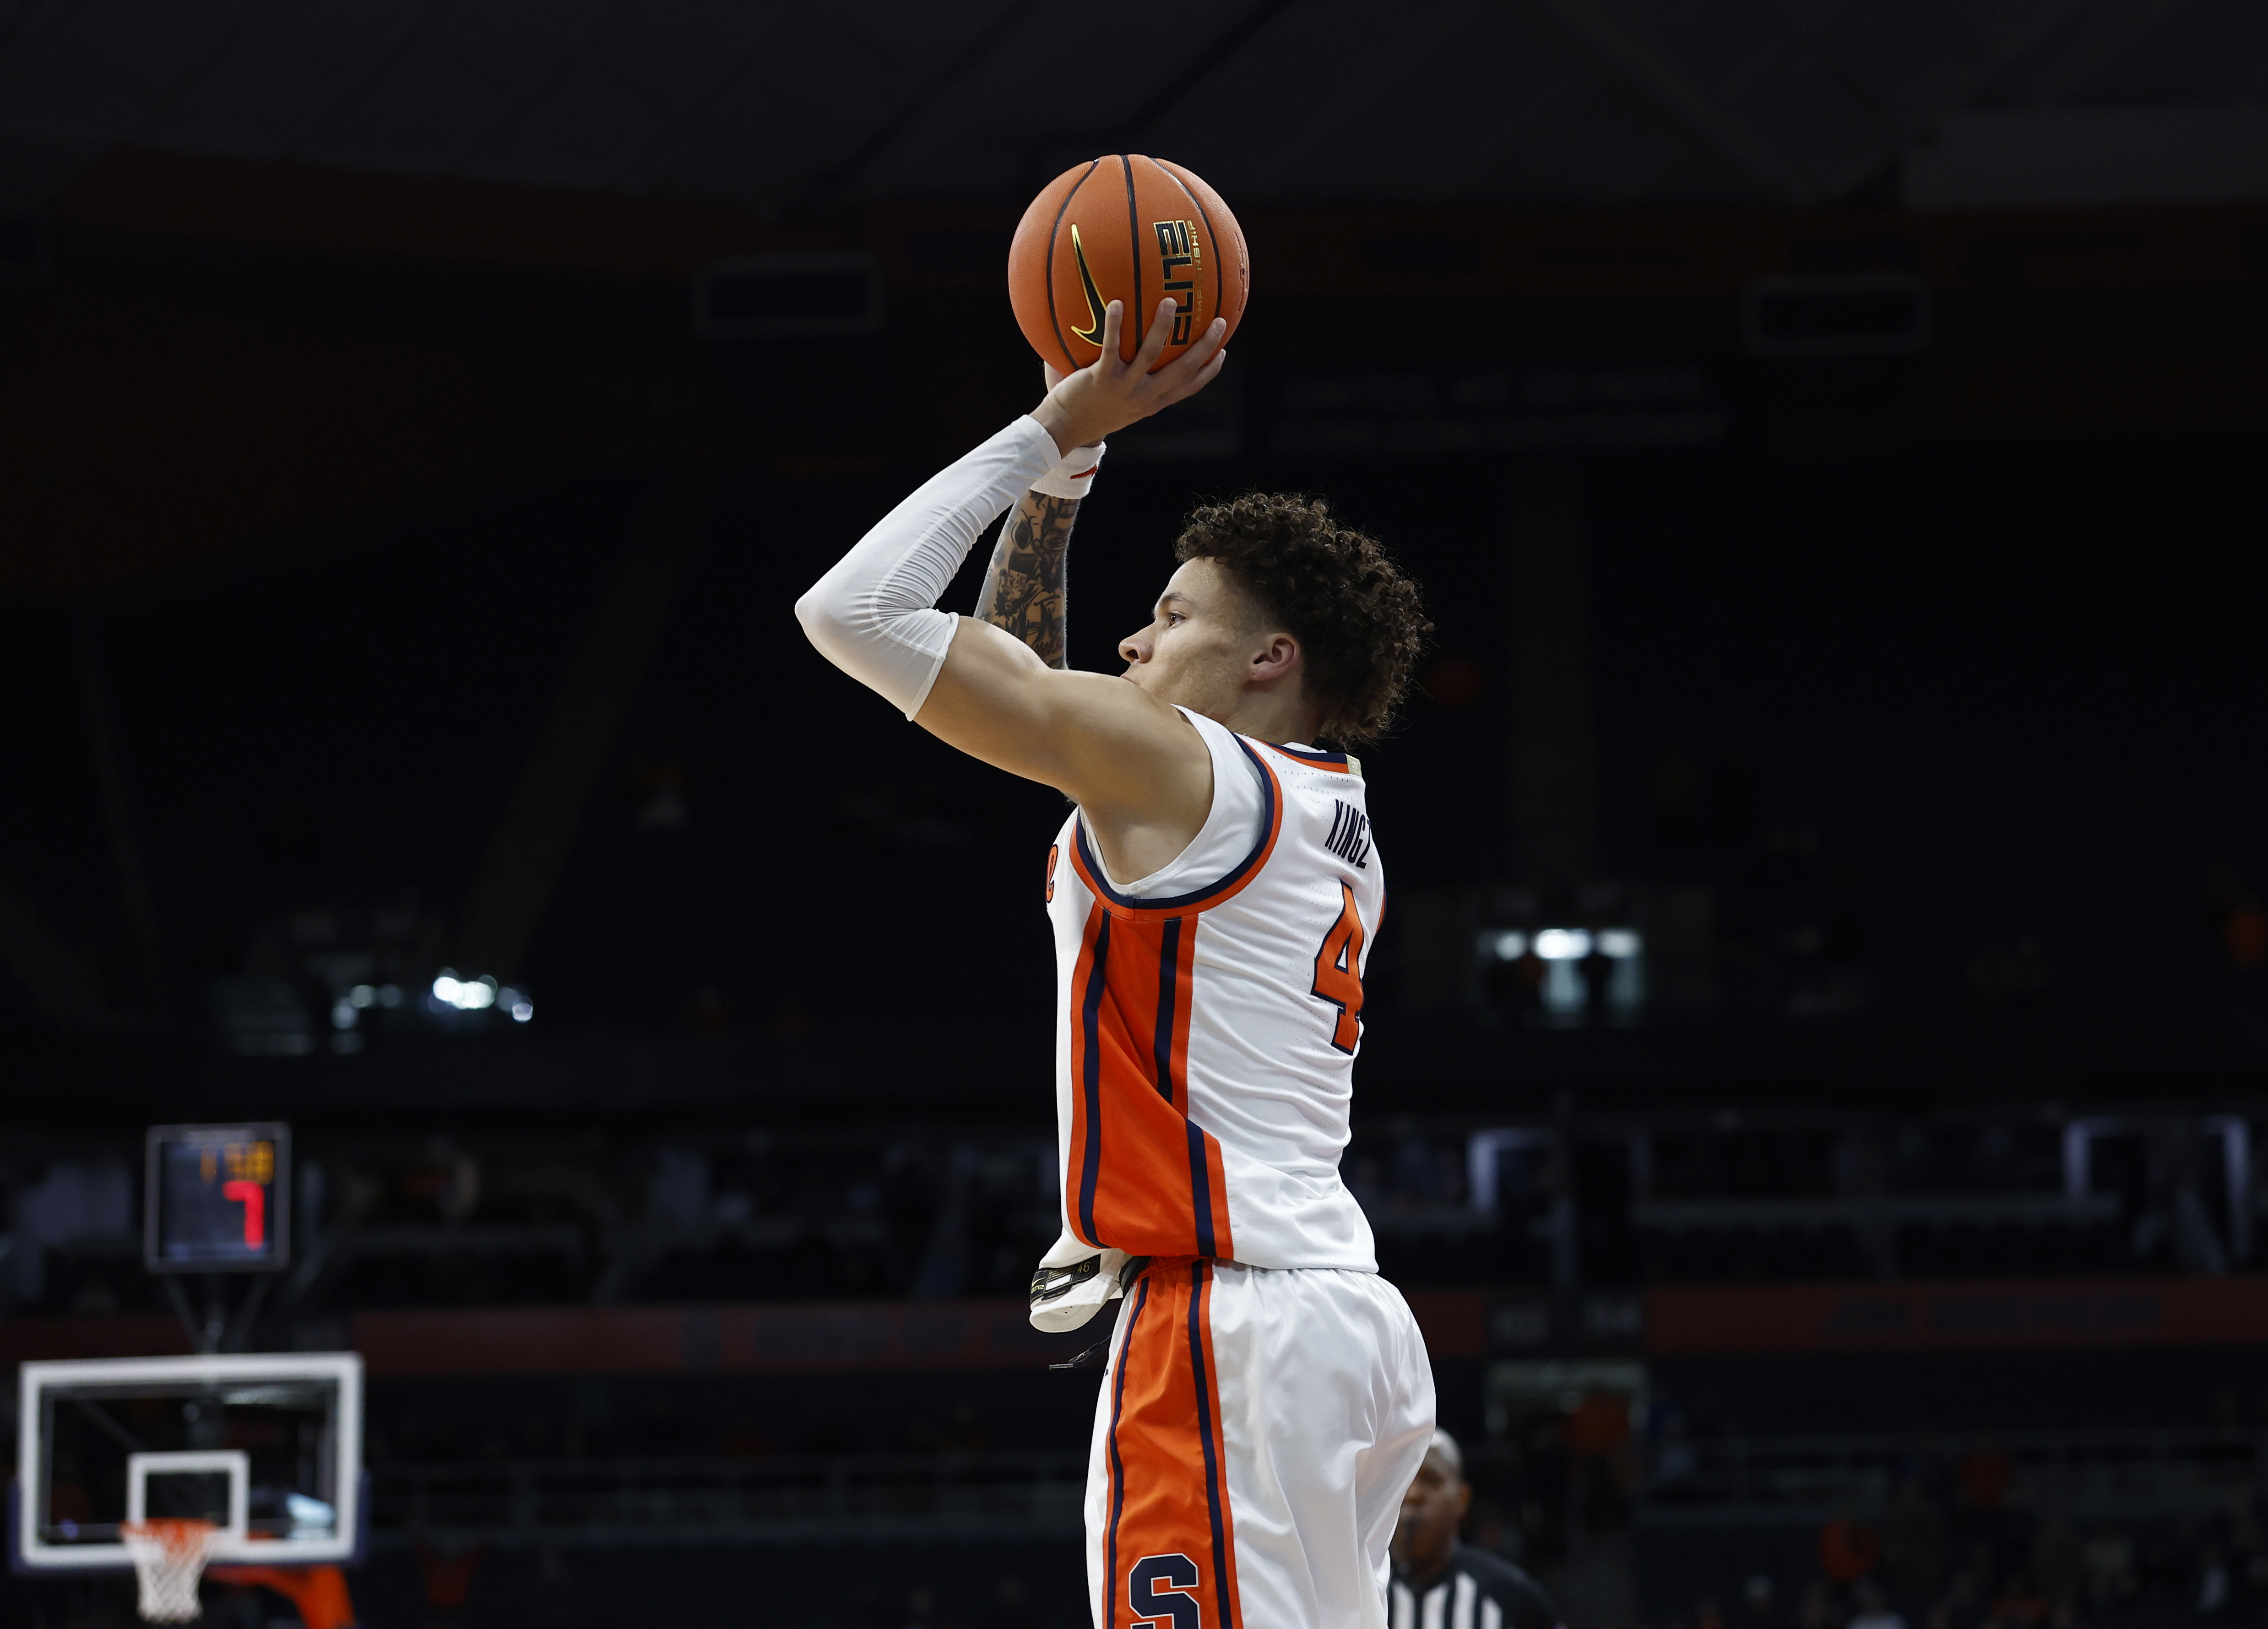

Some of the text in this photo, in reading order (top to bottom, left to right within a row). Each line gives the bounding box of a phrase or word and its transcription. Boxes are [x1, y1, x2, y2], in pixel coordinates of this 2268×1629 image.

[1153, 220, 1194, 346] ELITE
[1188, 219, 1204, 331] AMPIONSHIP
[1324, 798, 1372, 869] KINGZ
[1310, 878, 1364, 1056] 4
[222, 1180, 265, 1251] 7
[1077, 1261, 1090, 1273] 46
[1129, 1553, 1201, 1629] S
